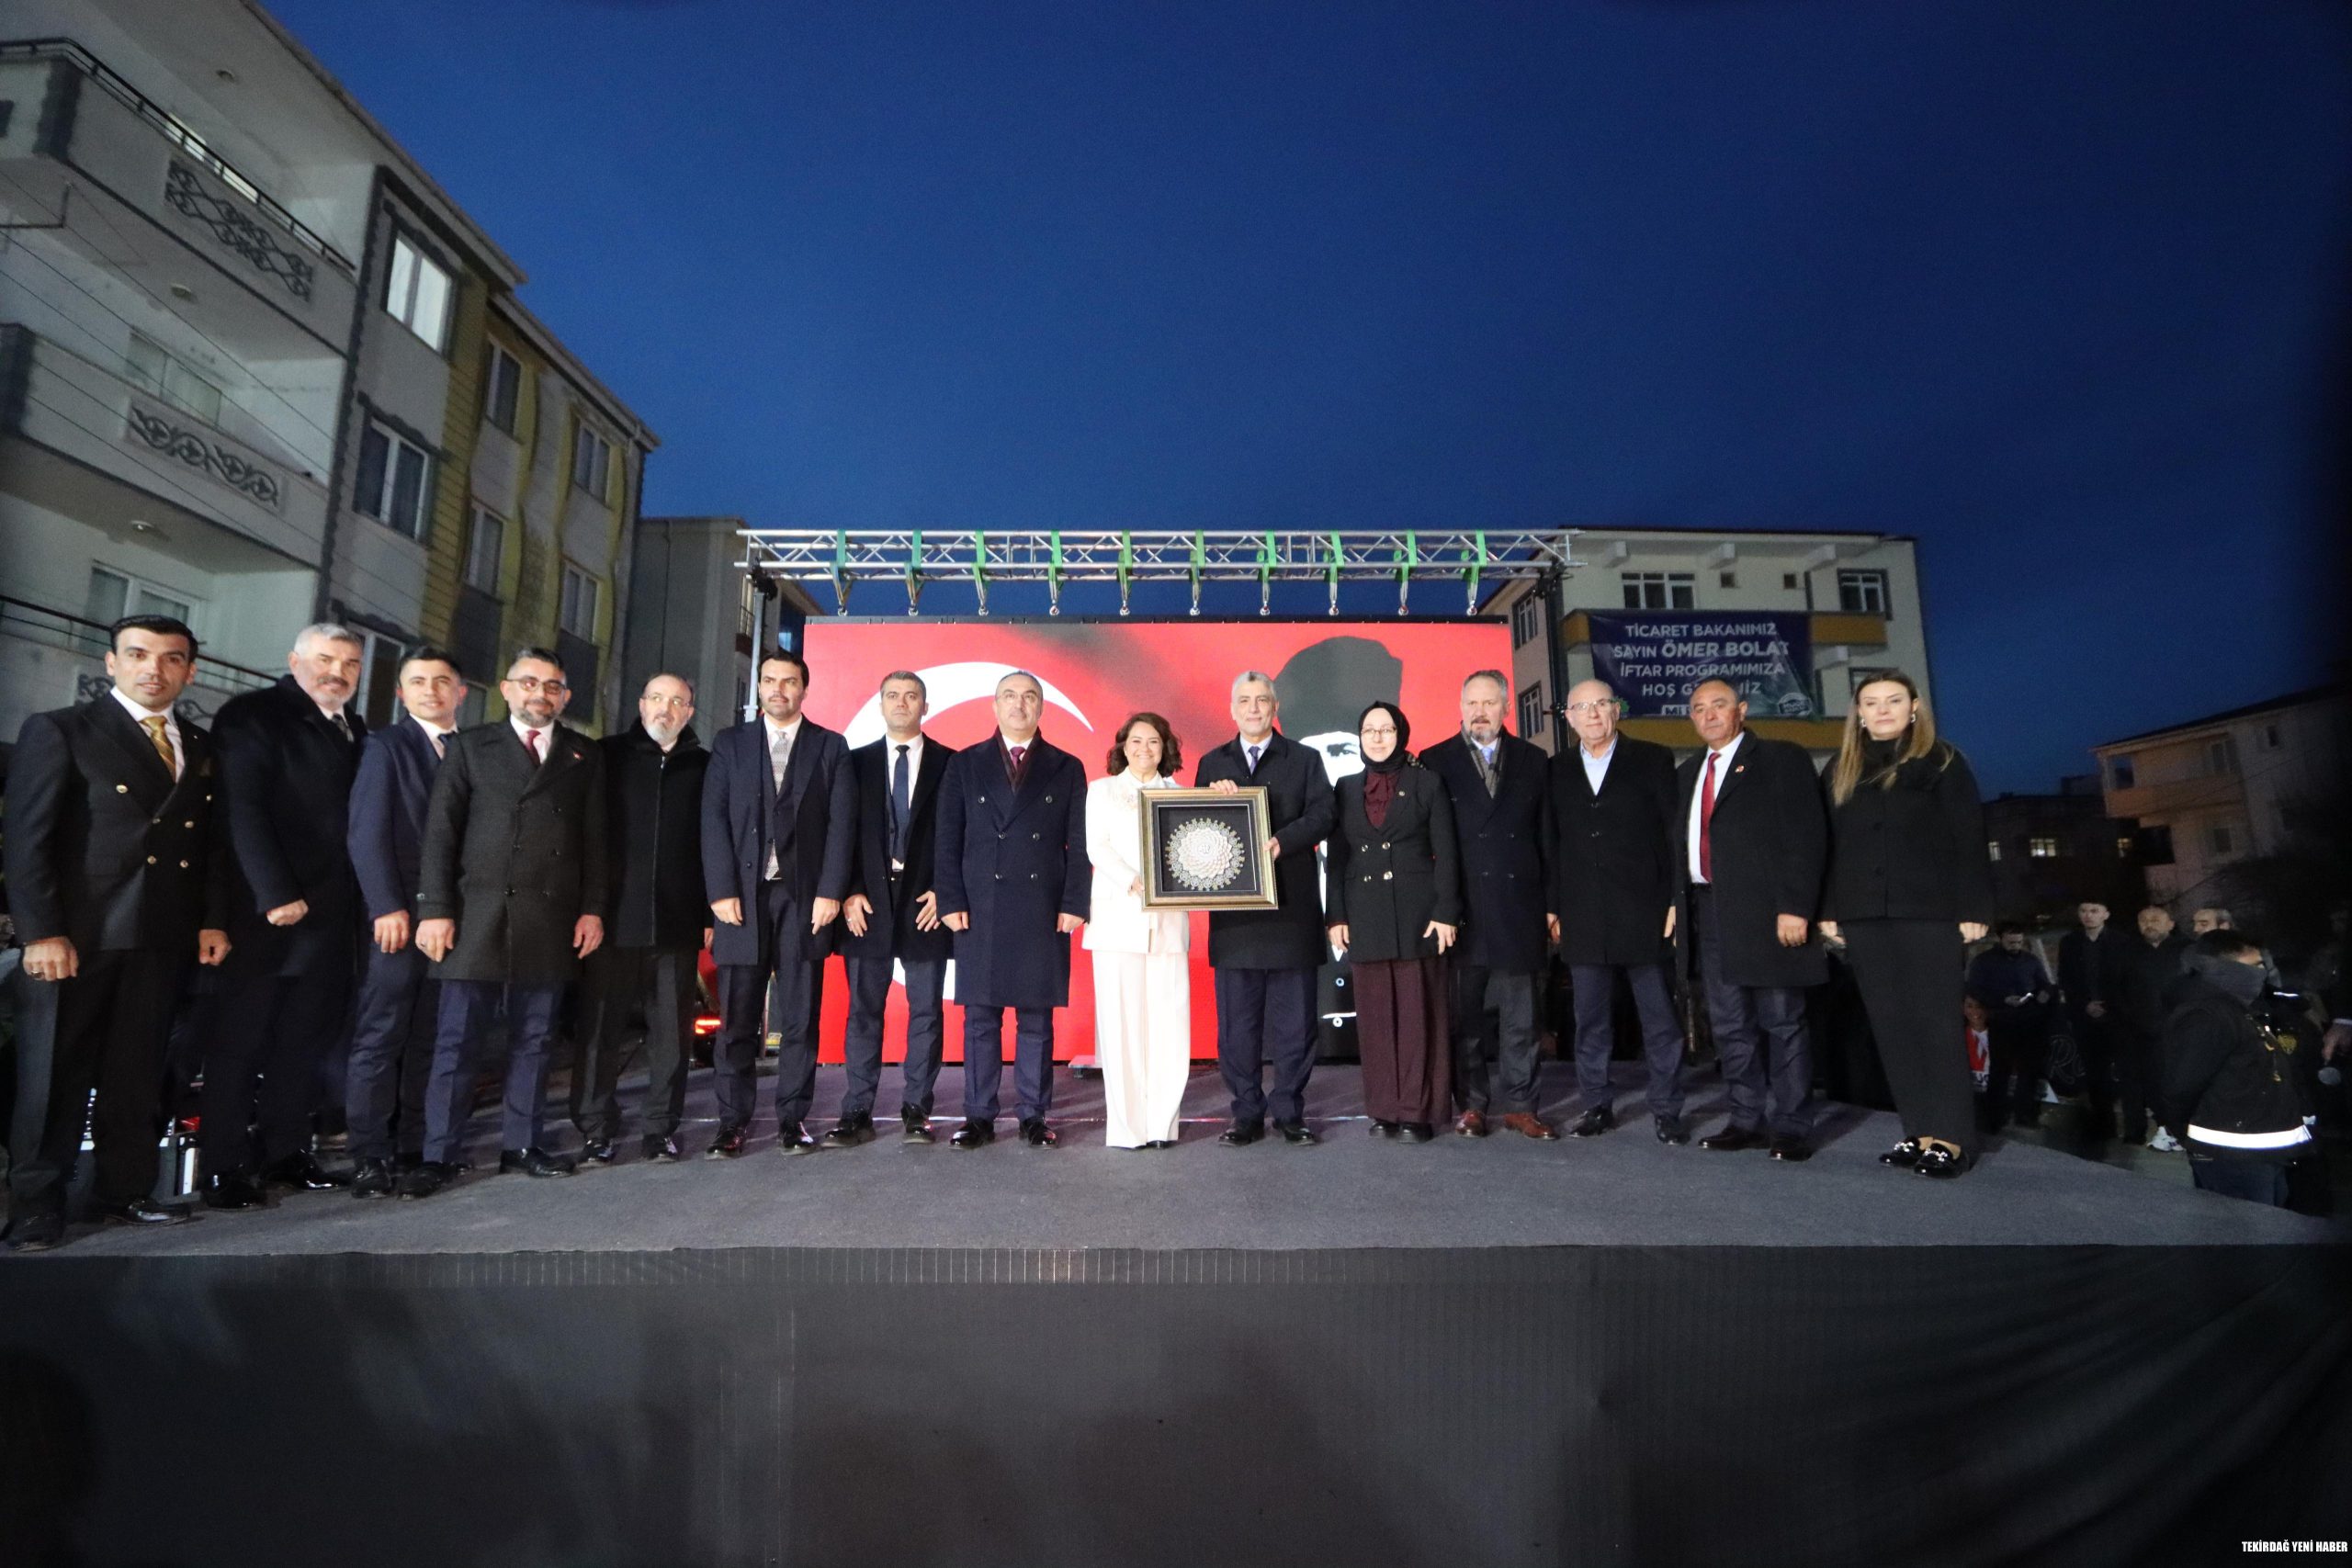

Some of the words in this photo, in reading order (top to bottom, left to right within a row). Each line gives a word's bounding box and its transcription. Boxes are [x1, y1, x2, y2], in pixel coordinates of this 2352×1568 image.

[1626, 624, 1689, 637] TİCARET
[1693, 623, 1776, 637] BAKANIMIZ
[1613, 645, 1657, 659] SAYIN
[1662, 639, 1719, 658] ÖMER
[1725, 641, 1789, 657] BOLAT
[1621, 662, 1662, 677] İFTAR
[1666, 662, 1785, 677] PROGRAMIMIZA
[1642, 683, 1676, 698] HOŞ
